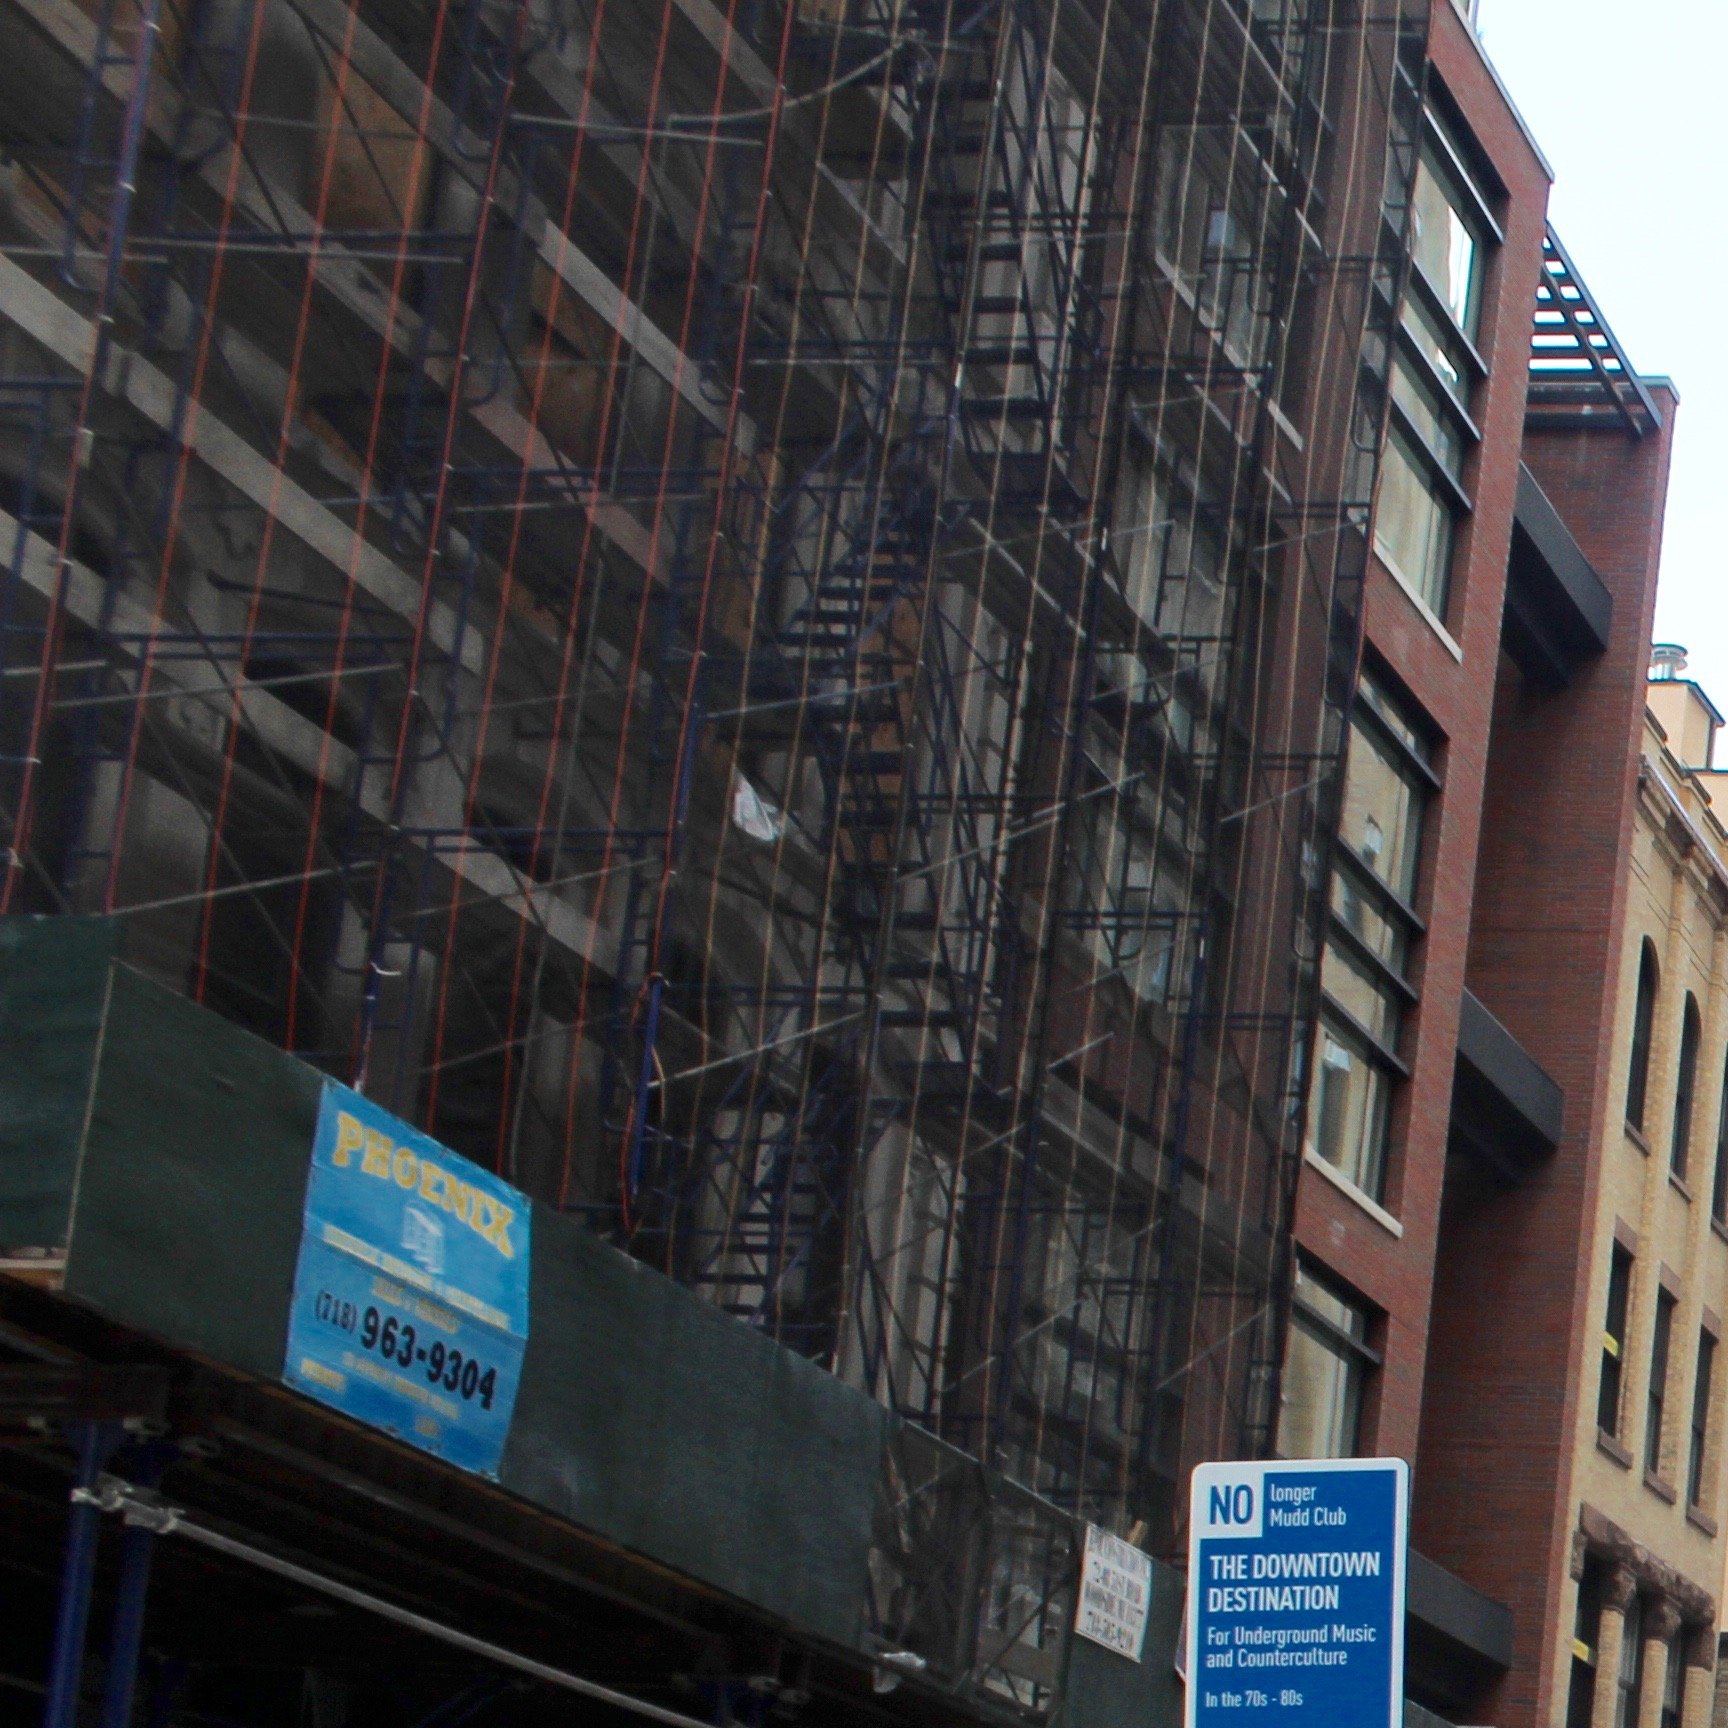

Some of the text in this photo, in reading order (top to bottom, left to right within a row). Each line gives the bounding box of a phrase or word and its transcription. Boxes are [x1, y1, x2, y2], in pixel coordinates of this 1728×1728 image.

[332, 1110, 515, 1259] PHOENIX
[361, 1306, 498, 1411] 963-9304
[1209, 1484, 1317, 1525] NO longer
[1270, 1507, 1347, 1527] Mudd Club
[1210, 1551, 1380, 1580] THE DOWNTOWN
[1208, 1585, 1339, 1612] DESTINATION
[1208, 1624, 1376, 1648] For Underground Music
[1206, 1647, 1347, 1668] and Counterculture
[1206, 1691, 1218, 1708] In
[1221, 1691, 1241, 1707] the
[1245, 1690, 1267, 1706] 70s
[1281, 1690, 1303, 1706] 80s
